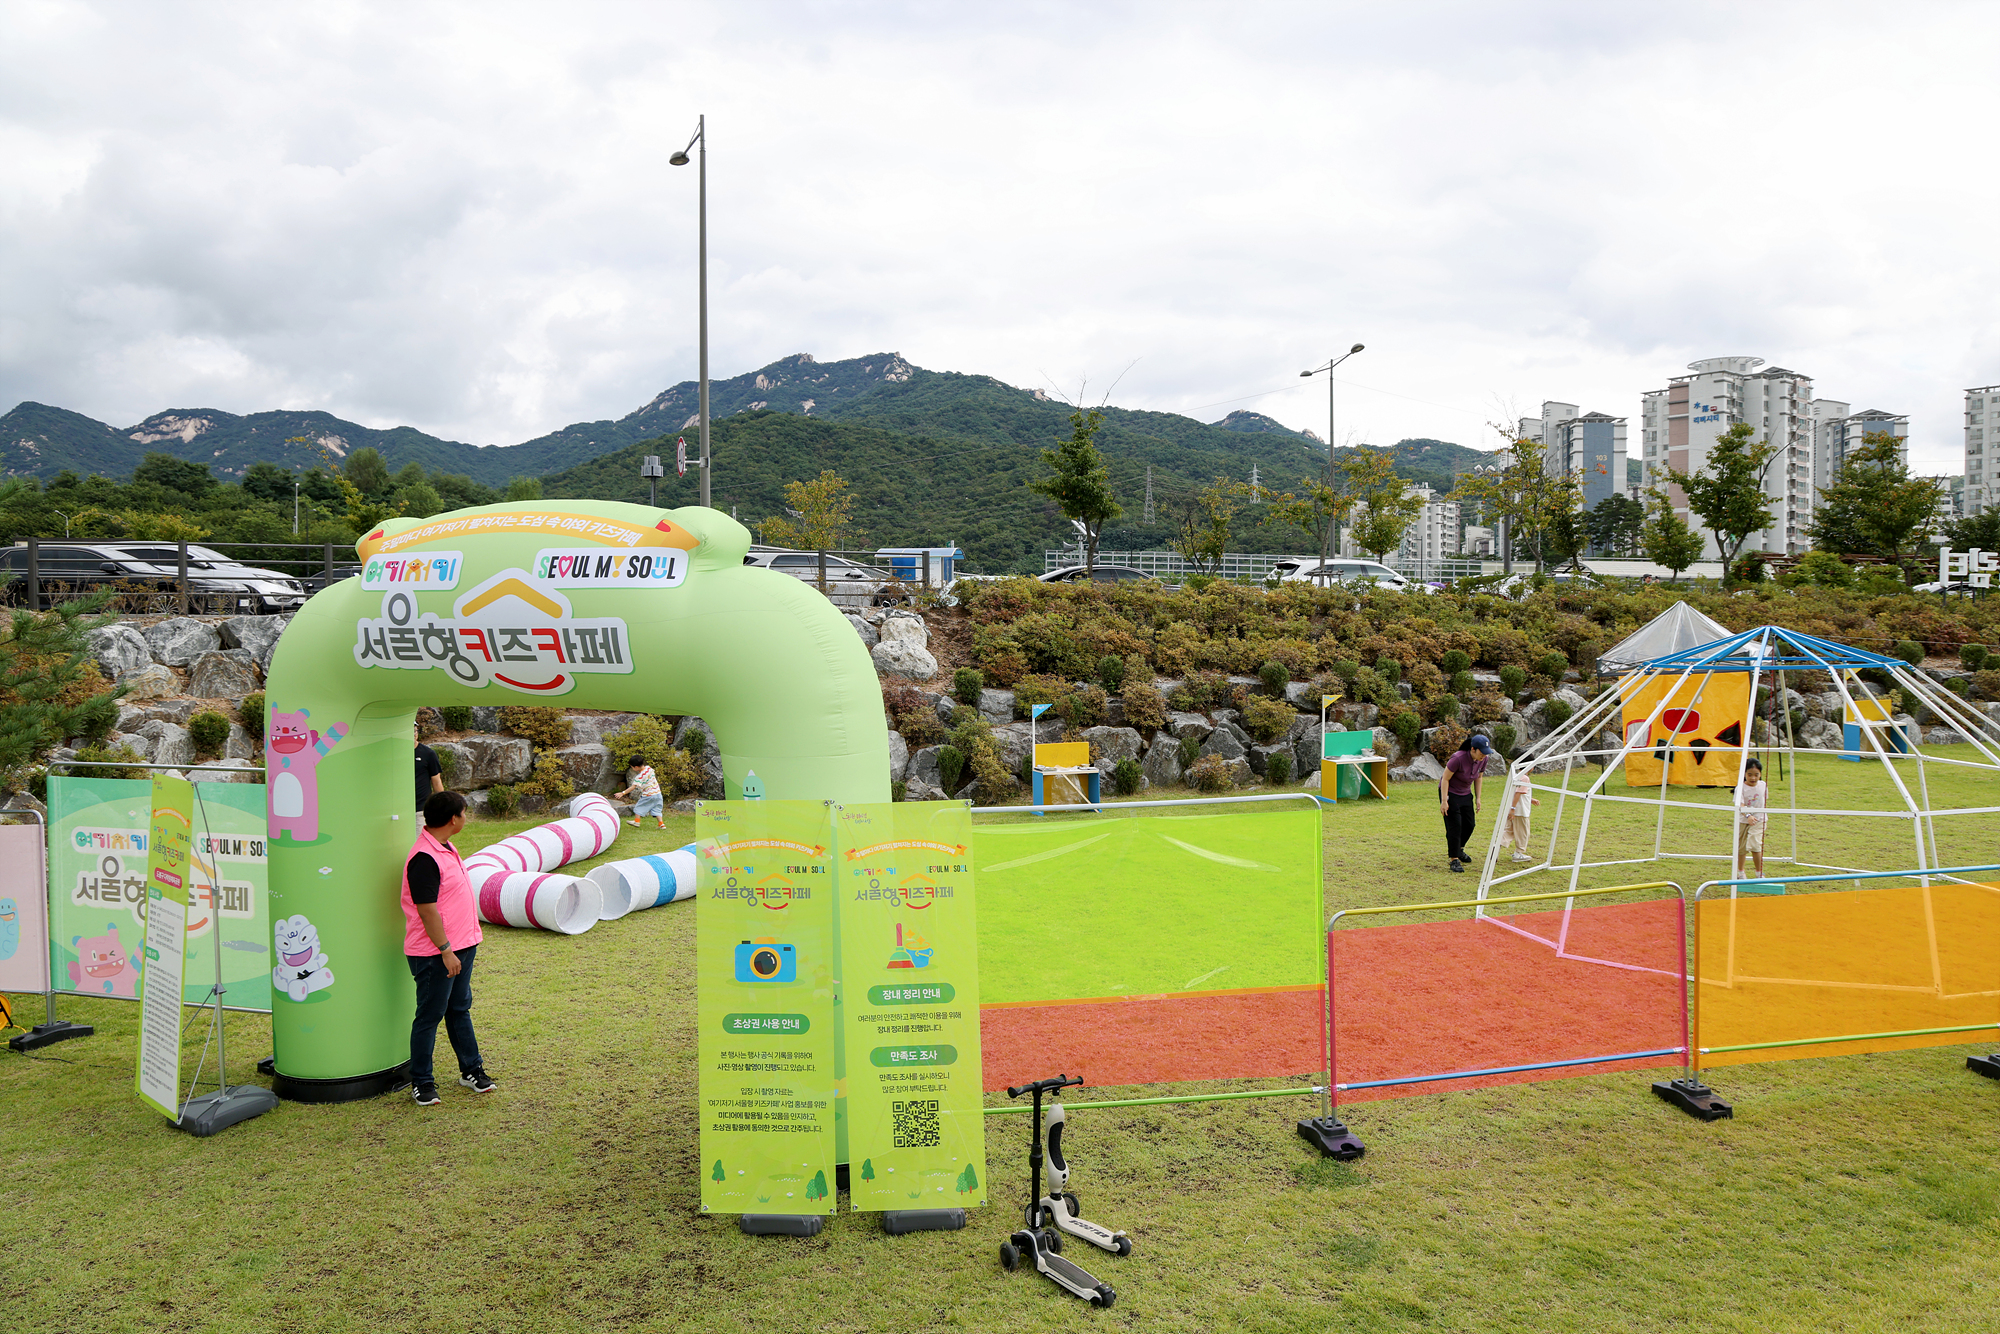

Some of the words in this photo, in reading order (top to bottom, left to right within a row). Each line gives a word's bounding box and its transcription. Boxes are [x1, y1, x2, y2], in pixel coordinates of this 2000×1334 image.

[1694, 414, 1720, 424] 리버시티
[380, 529, 422, 552] 주말마다
[422, 518, 468, 536] 여기저기
[468, 516, 518, 529] 펼쳐지는
[517, 516, 547, 527] 도심
[546, 517, 560, 528] 속
[560, 518, 590, 532] 야외
[589, 522, 644, 547] 키즈카페
[366, 558, 456, 583] 여기저기
[76, 832, 146, 850] 여기저기
[711, 866, 754, 874] 여기저기
[853, 868, 896, 876] 여기저기
[883, 990, 900, 1000] 장내
[902, 989, 920, 999] 정리
[922, 988, 940, 998] 안내
[858, 1014, 883, 1023] 여러분의
[884, 1013, 909, 1022] 안전하고
[929, 1012, 947, 1020] 이용을
[948, 1011, 962, 1019] 위해
[733, 1018, 760, 1029] 초상권
[762, 1019, 780, 1029] 사용
[782, 1019, 800, 1029] 안내
[877, 1026, 890, 1034] 장내
[911, 1024, 943, 1033] 진행합니다.
[774, 1052, 793, 1060] 기록을
[794, 1052, 812, 1060] 위하여
[890, 1051, 917, 1061] 만족도
[920, 1050, 937, 1060] 조사
[791, 1064, 816, 1072] 있습니다.
[879, 1073, 898, 1081] 만족도
[899, 1073, 917, 1081] 조사를
[919, 1072, 950, 1080] 실시하오니
[775, 1088, 793, 1096] 자료는
[896, 1085, 908, 1093] 참여
[909, 1084, 948, 1092] 부탁드립니다.
[781, 1100, 793, 1108] 사업
[814, 1101, 827, 1109] 위한
[771, 1112, 789, 1120] 있음을
[712, 1124, 731, 1132] 초상권
[732, 1124, 751, 1132] 활용에
[752, 1124, 770, 1132] 동의한
[771, 1124, 789, 1132] 것으로
[790, 1124, 823, 1133] 간주됩니다.
